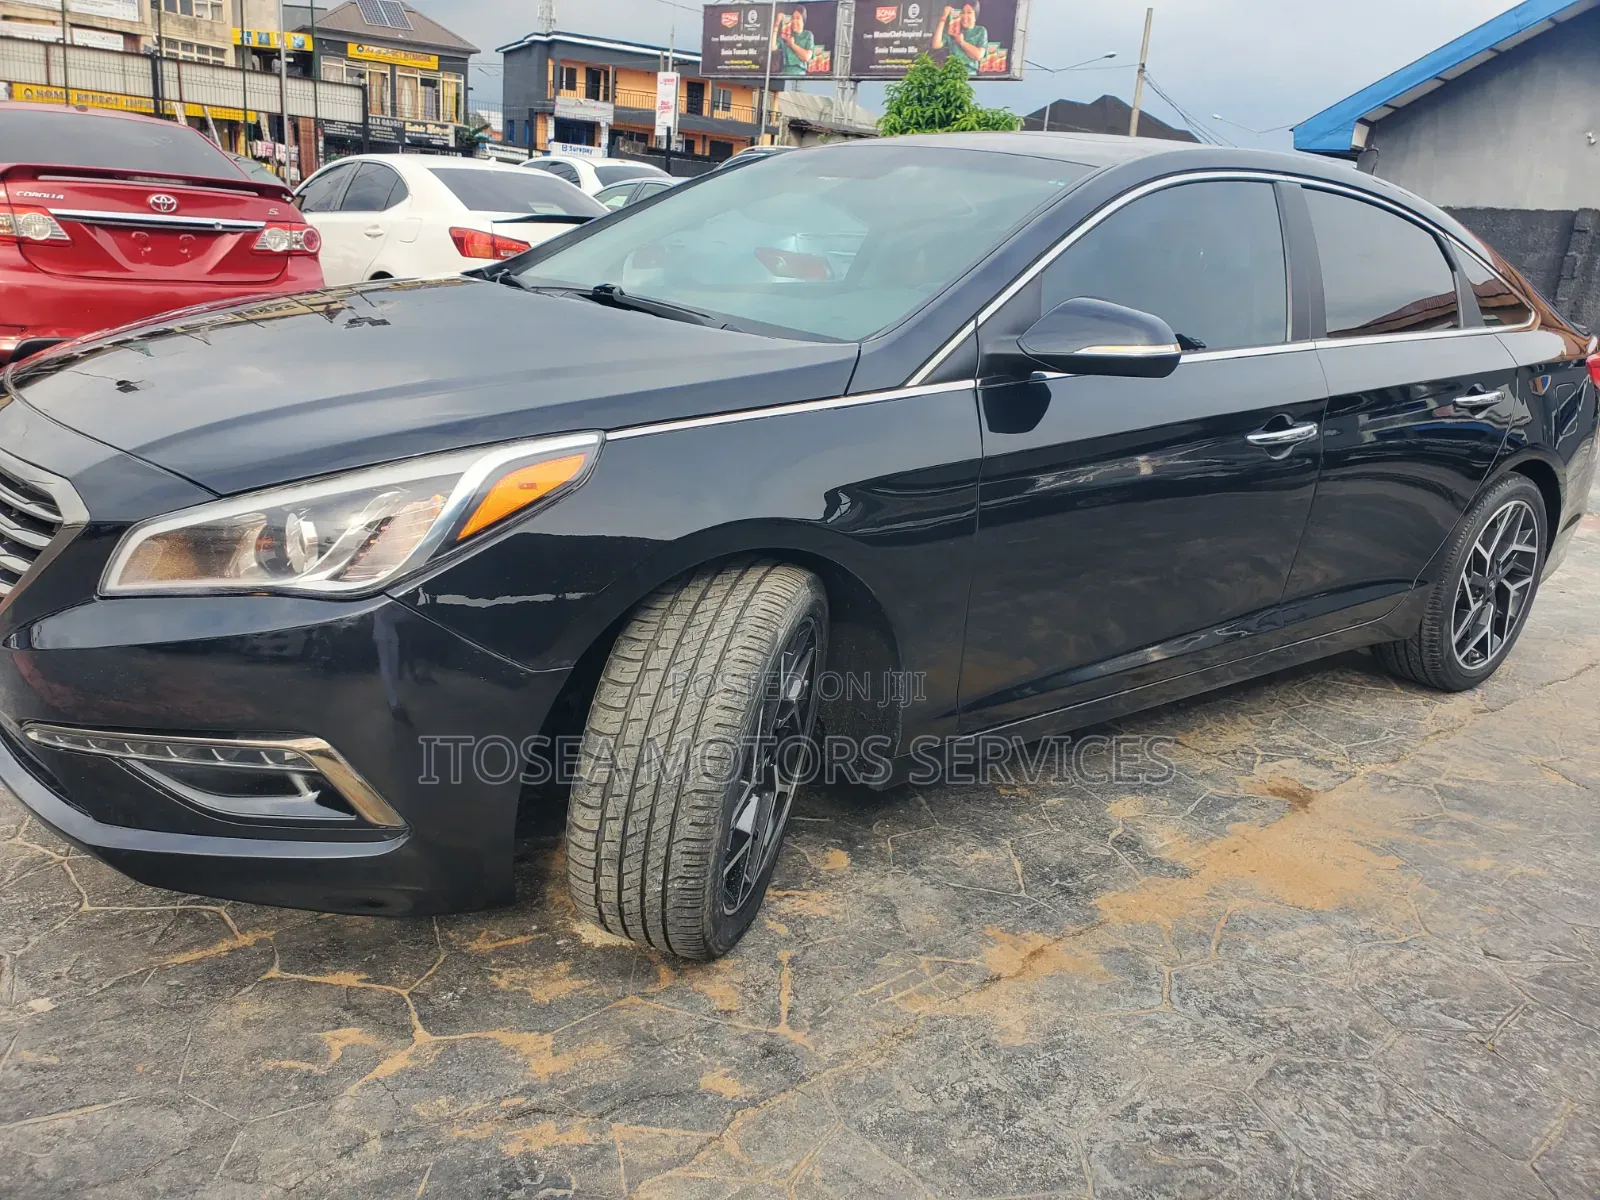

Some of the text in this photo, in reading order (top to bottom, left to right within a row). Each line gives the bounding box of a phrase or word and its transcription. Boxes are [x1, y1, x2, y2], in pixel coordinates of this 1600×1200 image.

[36, 88, 71, 100] HOM
[16, 190, 64, 200] COROLLA
[267, 208, 279, 216] S
